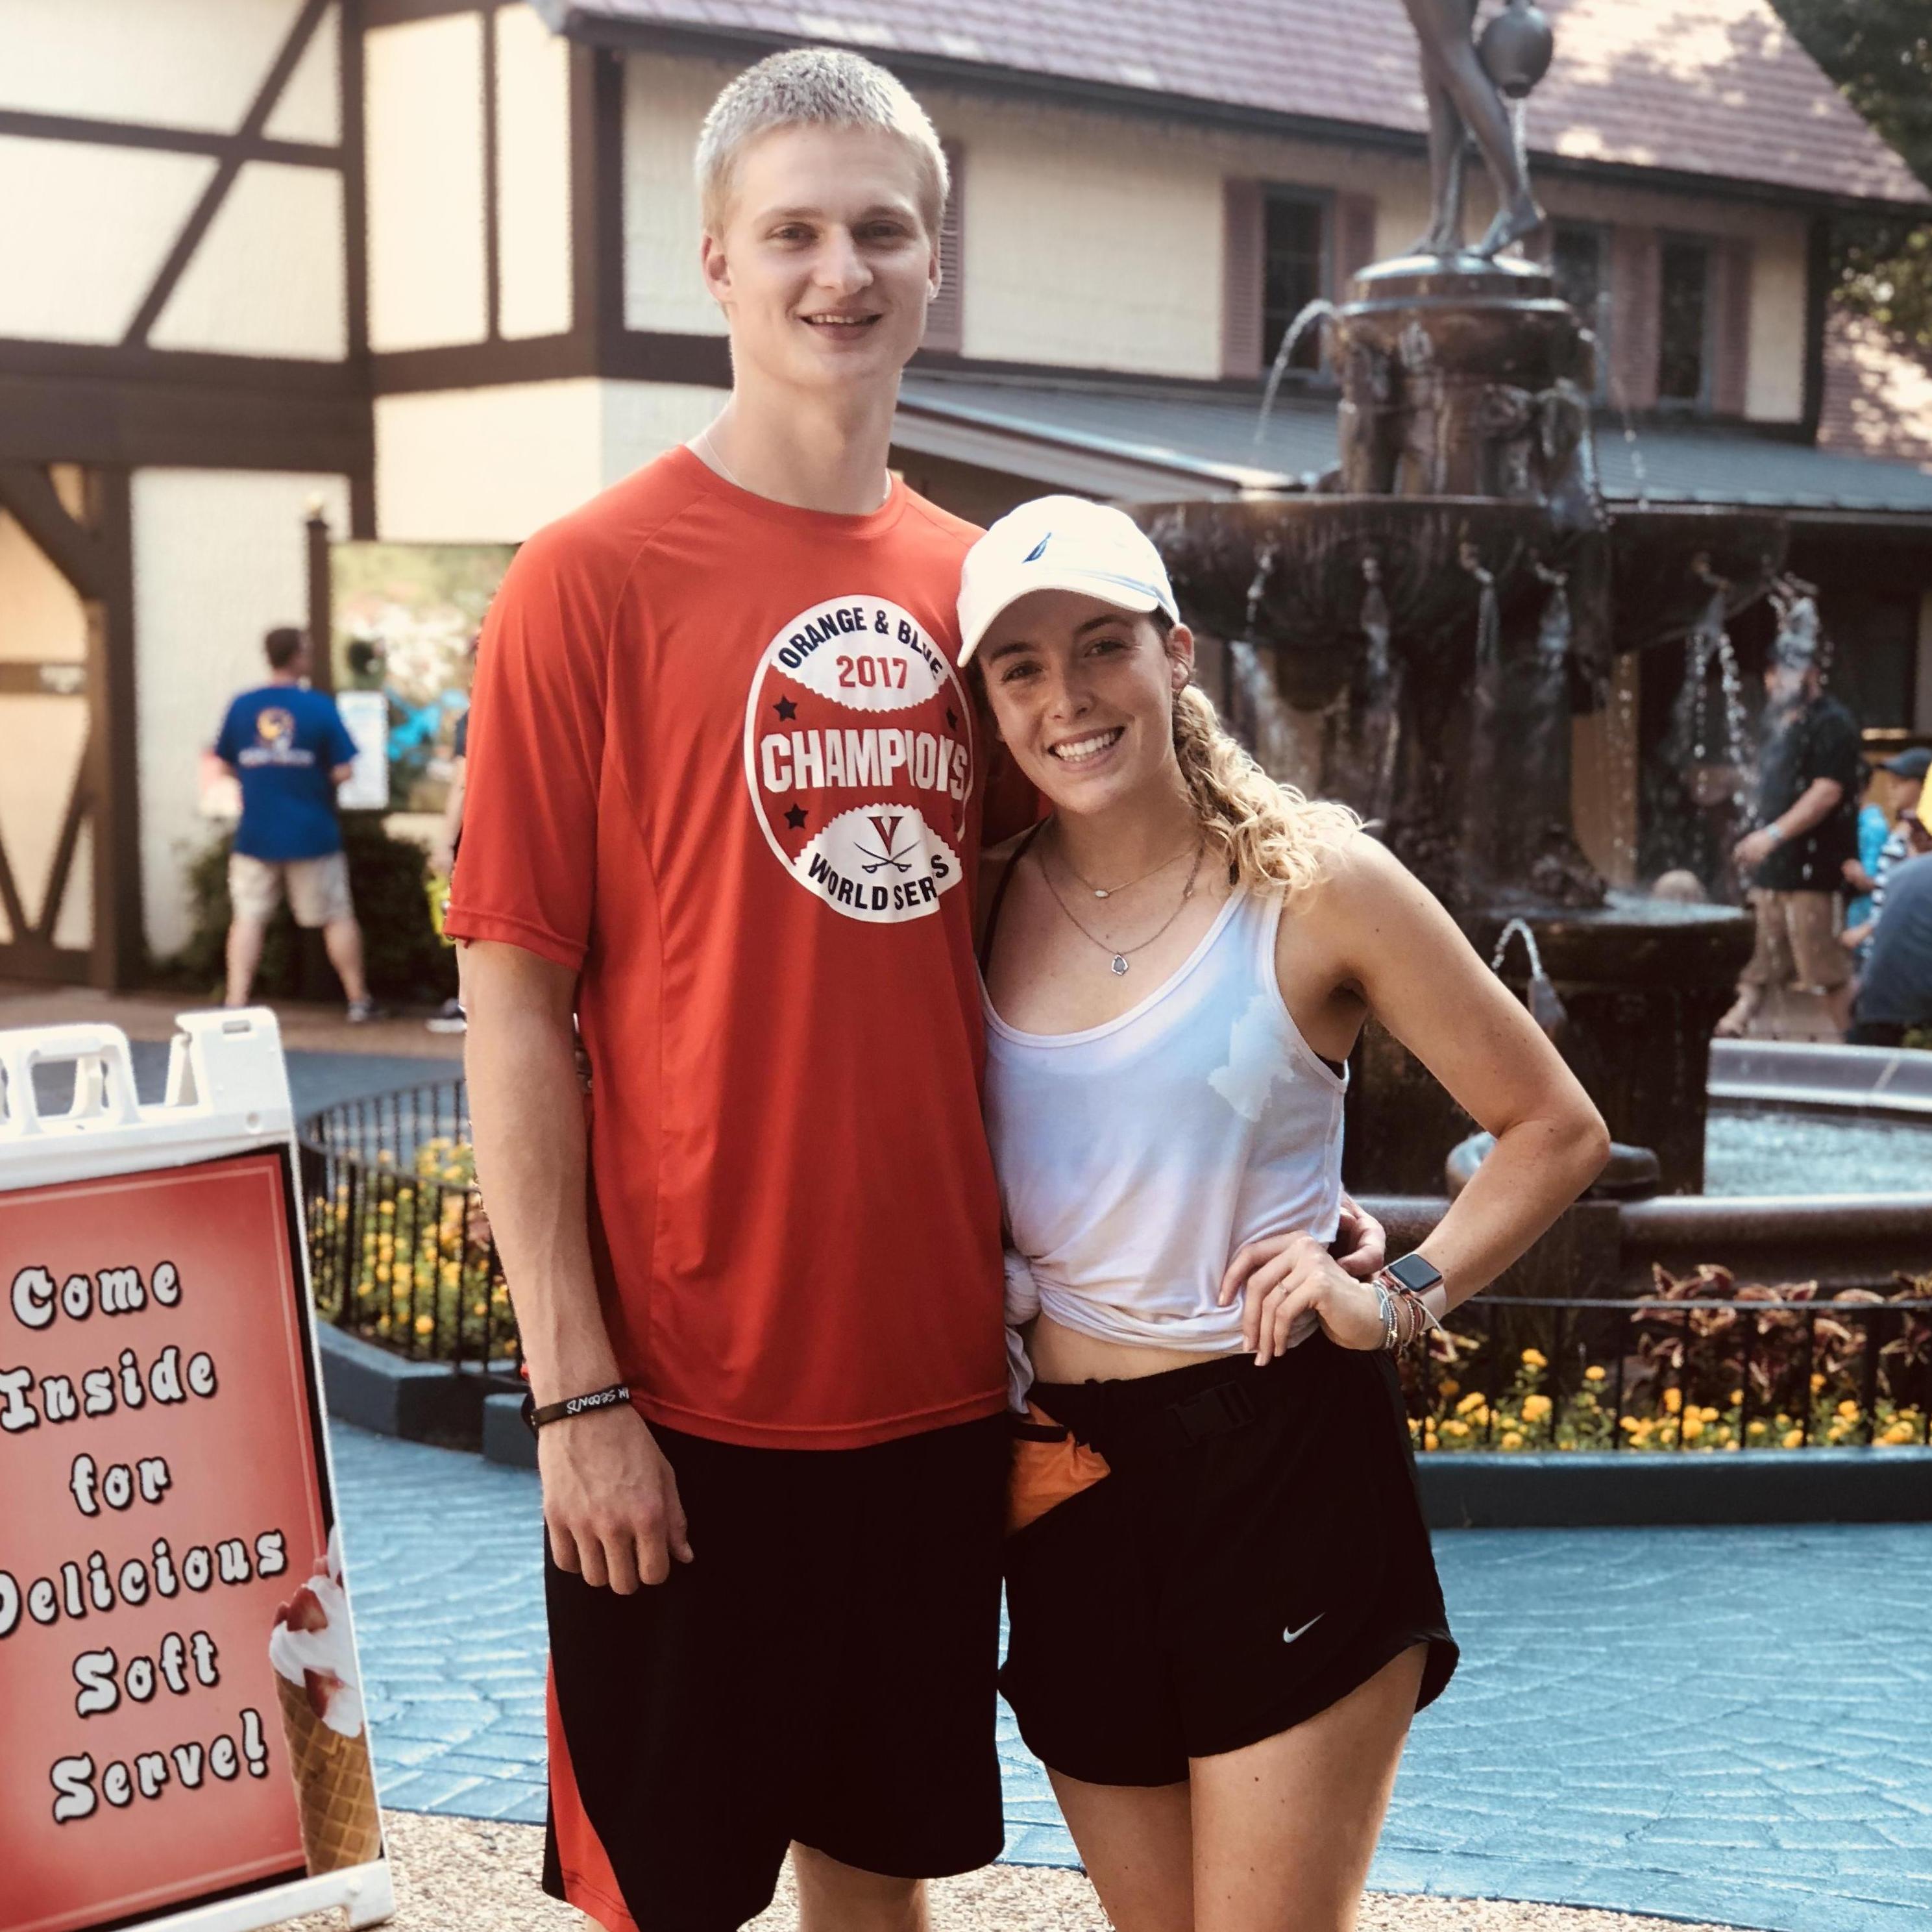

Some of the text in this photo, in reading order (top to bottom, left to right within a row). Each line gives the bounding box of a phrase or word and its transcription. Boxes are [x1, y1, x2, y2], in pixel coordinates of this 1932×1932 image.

[778, 607, 943, 680] ORANGE & BLUE
[836, 655, 908, 689] 2017
[761, 728, 968, 801] CHAMPIONS
[808, 852, 888, 911] WORLD
[10, 1261, 182, 1330] Come
[0, 1345, 218, 1434] Inside
[69, 1454, 171, 1517] for
[73, 1631, 220, 1718] Soft
[50, 1708, 269, 1824] Serve!
